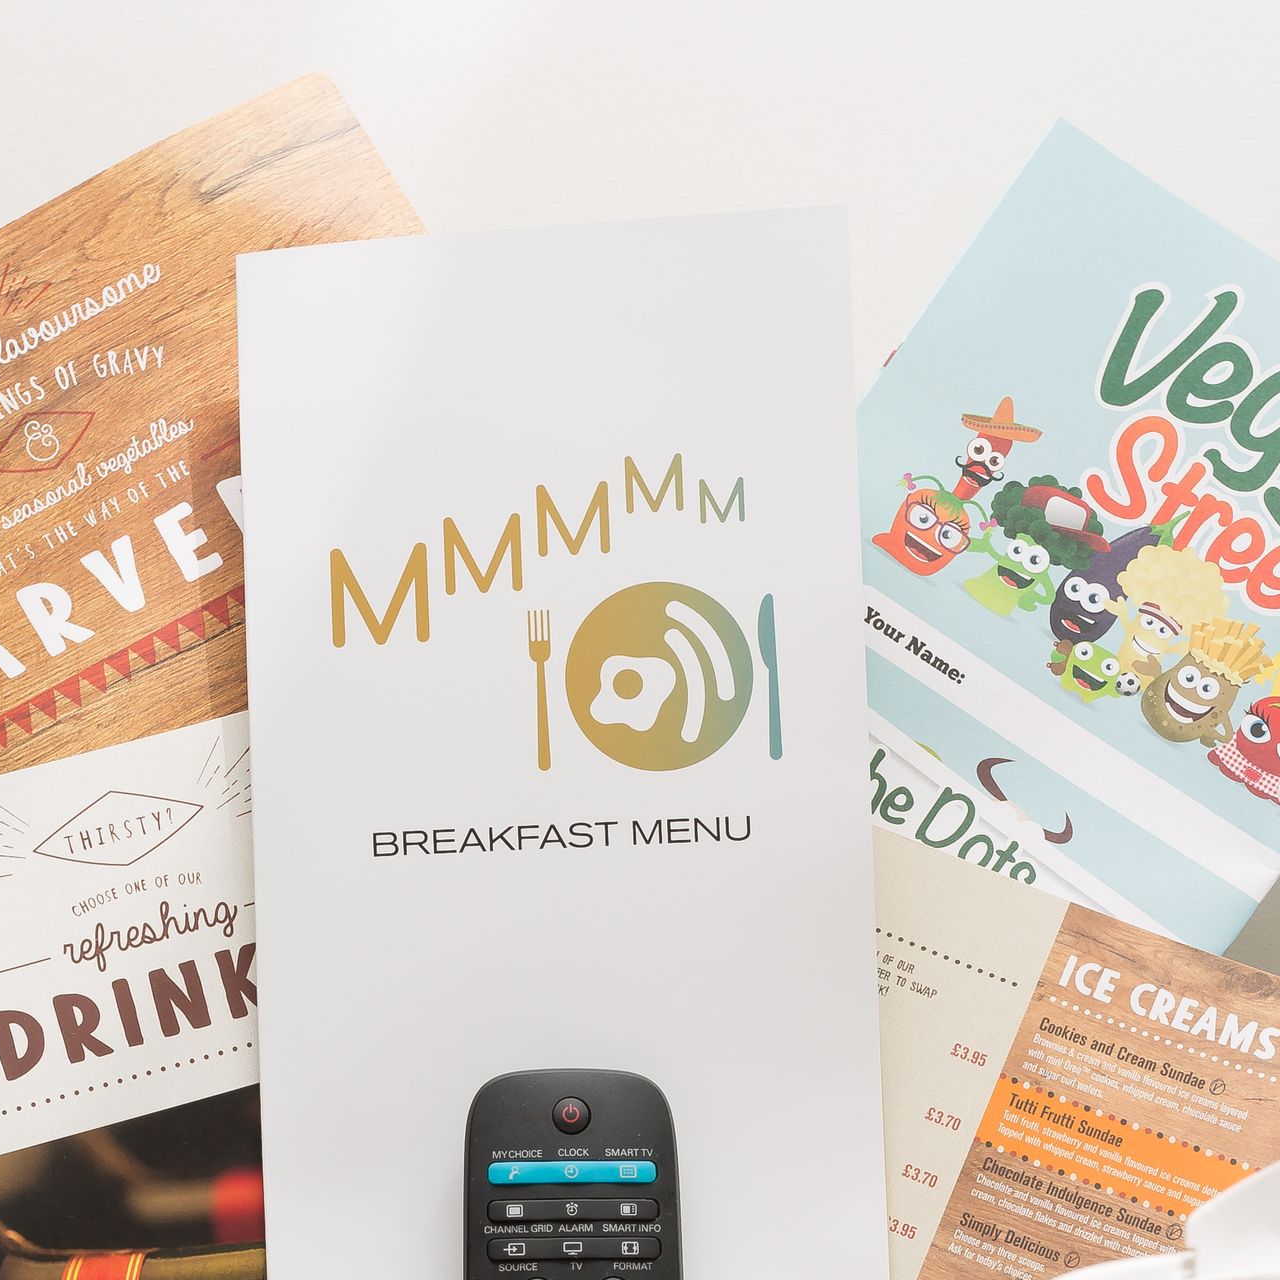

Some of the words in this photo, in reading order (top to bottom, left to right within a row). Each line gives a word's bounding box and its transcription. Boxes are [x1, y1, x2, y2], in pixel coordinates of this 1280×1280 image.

[54, 360, 80, 391] OF
[92, 345, 166, 380] GRAVY
[23, 419, 61, 463] &
[0, 462, 94, 534] seasonal
[95, 417, 195, 482] vegetables
[41, 519, 79, 551] THE
[83, 497, 121, 531] WAY
[127, 482, 151, 505] OF
[155, 458, 191, 490] THE
[863, 604, 908, 643] Your
[907, 635, 967, 686] Name:
[62, 806, 175, 857] THIRSTY?
[371, 820, 619, 858] BREAKFAST
[631, 814, 753, 846] MENU
[70, 886, 119, 917] CHOOSE
[124, 878, 149, 896] ONE
[154, 873, 170, 889] OF
[176, 870, 203, 887] OUR
[62, 900, 239, 973] refreshing
[882, 953, 895, 966] OF
[896, 959, 916, 975] OUR
[895, 974, 908, 988] TO
[909, 981, 938, 999] SWAP
[1058, 954, 1121, 1005] ICE
[950, 1041, 989, 1068] £3.95
[1021, 1060, 1039, 1073] and
[1037, 1066, 1061, 1082] sugar
[1039, 1016, 1089, 1047] Cookies
[1089, 1038, 1116, 1057] and
[1116, 1045, 1158, 1073] Cream
[1159, 1061, 1207, 1091] Sundae
[1027, 1047, 1046, 1062] with
[1218, 1118, 1243, 1133] sauce
[1032, 1032, 1068, 1056] Brownies
[1075, 1051, 1101, 1068] cream
[1101, 1060, 1118, 1073] and
[1177, 1088, 1191, 1100] ice
[1190, 1093, 1219, 1111] creams
[1218, 1101, 1249, 1121] layered
[923, 1106, 963, 1132] £3.70
[1008, 1092, 1040, 1116] Tutti
[1039, 1105, 1077, 1131] Frutti
[1077, 1119, 1125, 1148] Sundae
[557, 1148, 590, 1158] CLOCK
[604, 1148, 638, 1158] SMART
[640, 1148, 654, 1158] TV
[997, 1122, 1025, 1141] Topped
[1024, 1134, 1042, 1148] with
[1042, 1142, 1075, 1161] whipped
[1100, 1164, 1143, 1188] strawberry
[1143, 1179, 1167, 1195] sauce
[1166, 1187, 1183, 1201] and
[1002, 1109, 1022, 1124] Tutti
[1041, 1126, 1083, 1149] strawberry
[1082, 1141, 1099, 1154] and
[1098, 1147, 1124, 1164] vanilla
[1123, 1156, 1160, 1178] flavoured
[1159, 1170, 1172, 1182] ice
[1171, 1175, 1201, 1192] creams
[901, 1162, 940, 1189] £3.70
[981, 1156, 1044, 1192] Chocolate
[1045, 1180, 1114, 1219] Indulgence
[1115, 1206, 1163, 1236] Sundae
[483, 1224, 529, 1235] CHANNEL
[530, 1223, 554, 1234] GRID
[558, 1223, 594, 1233] ALARM
[602, 1223, 637, 1233] SMART
[638, 1223, 662, 1233] INFO
[975, 1172, 1014, 1196] Chocolate
[1013, 1188, 1030, 1201] and
[1028, 1194, 1055, 1211] vanilla
[1053, 1203, 1091, 1225] flavoured
[1089, 1217, 1102, 1229] ice
[1102, 1223, 1131, 1241] creams
[1131, 1232, 1159, 1251] topped
[997, 1197, 1035, 1219] chocolate
[1034, 1209, 1058, 1228] flakes
[1057, 1221, 1074, 1234] and
[1102, 1238, 1122, 1252] with
[947, 1242, 964, 1256] Ask
[962, 1247, 977, 1260] for
[953, 1227, 981, 1248] Choose
[981, 1240, 997, 1255] any
[996, 1245, 1018, 1262] three
[959, 1211, 1003, 1242] Simply
[1003, 1229, 1062, 1262] Delicious
[498, 1262, 539, 1273] SOURCE
[570, 1262, 584, 1272] TV
[613, 1261, 653, 1272] FORMAT
